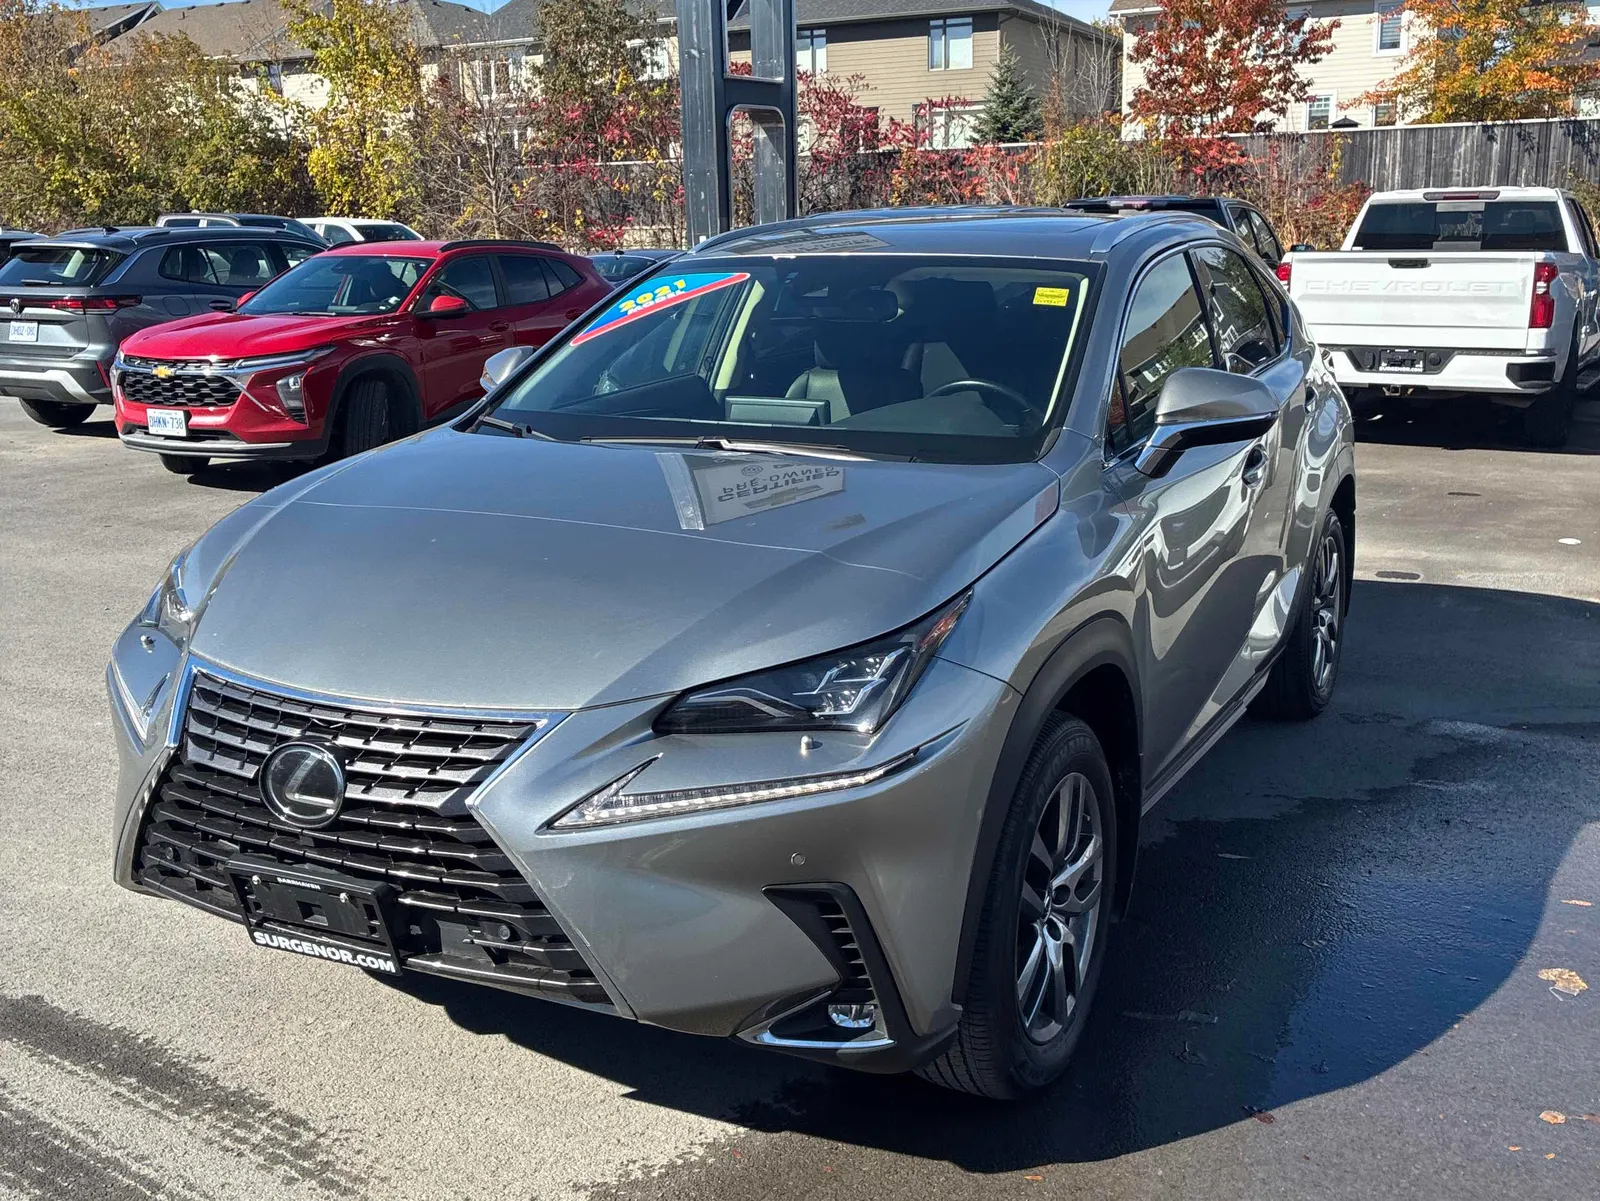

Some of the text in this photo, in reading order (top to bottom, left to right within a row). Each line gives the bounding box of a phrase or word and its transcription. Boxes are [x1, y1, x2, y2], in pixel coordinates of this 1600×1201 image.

[618, 279, 687, 313] 2021
[1306, 280, 1512, 292] CHEVROLET
[627, 289, 688, 316] MODEL
[253, 931, 396, 973] SURGENOR.COM
